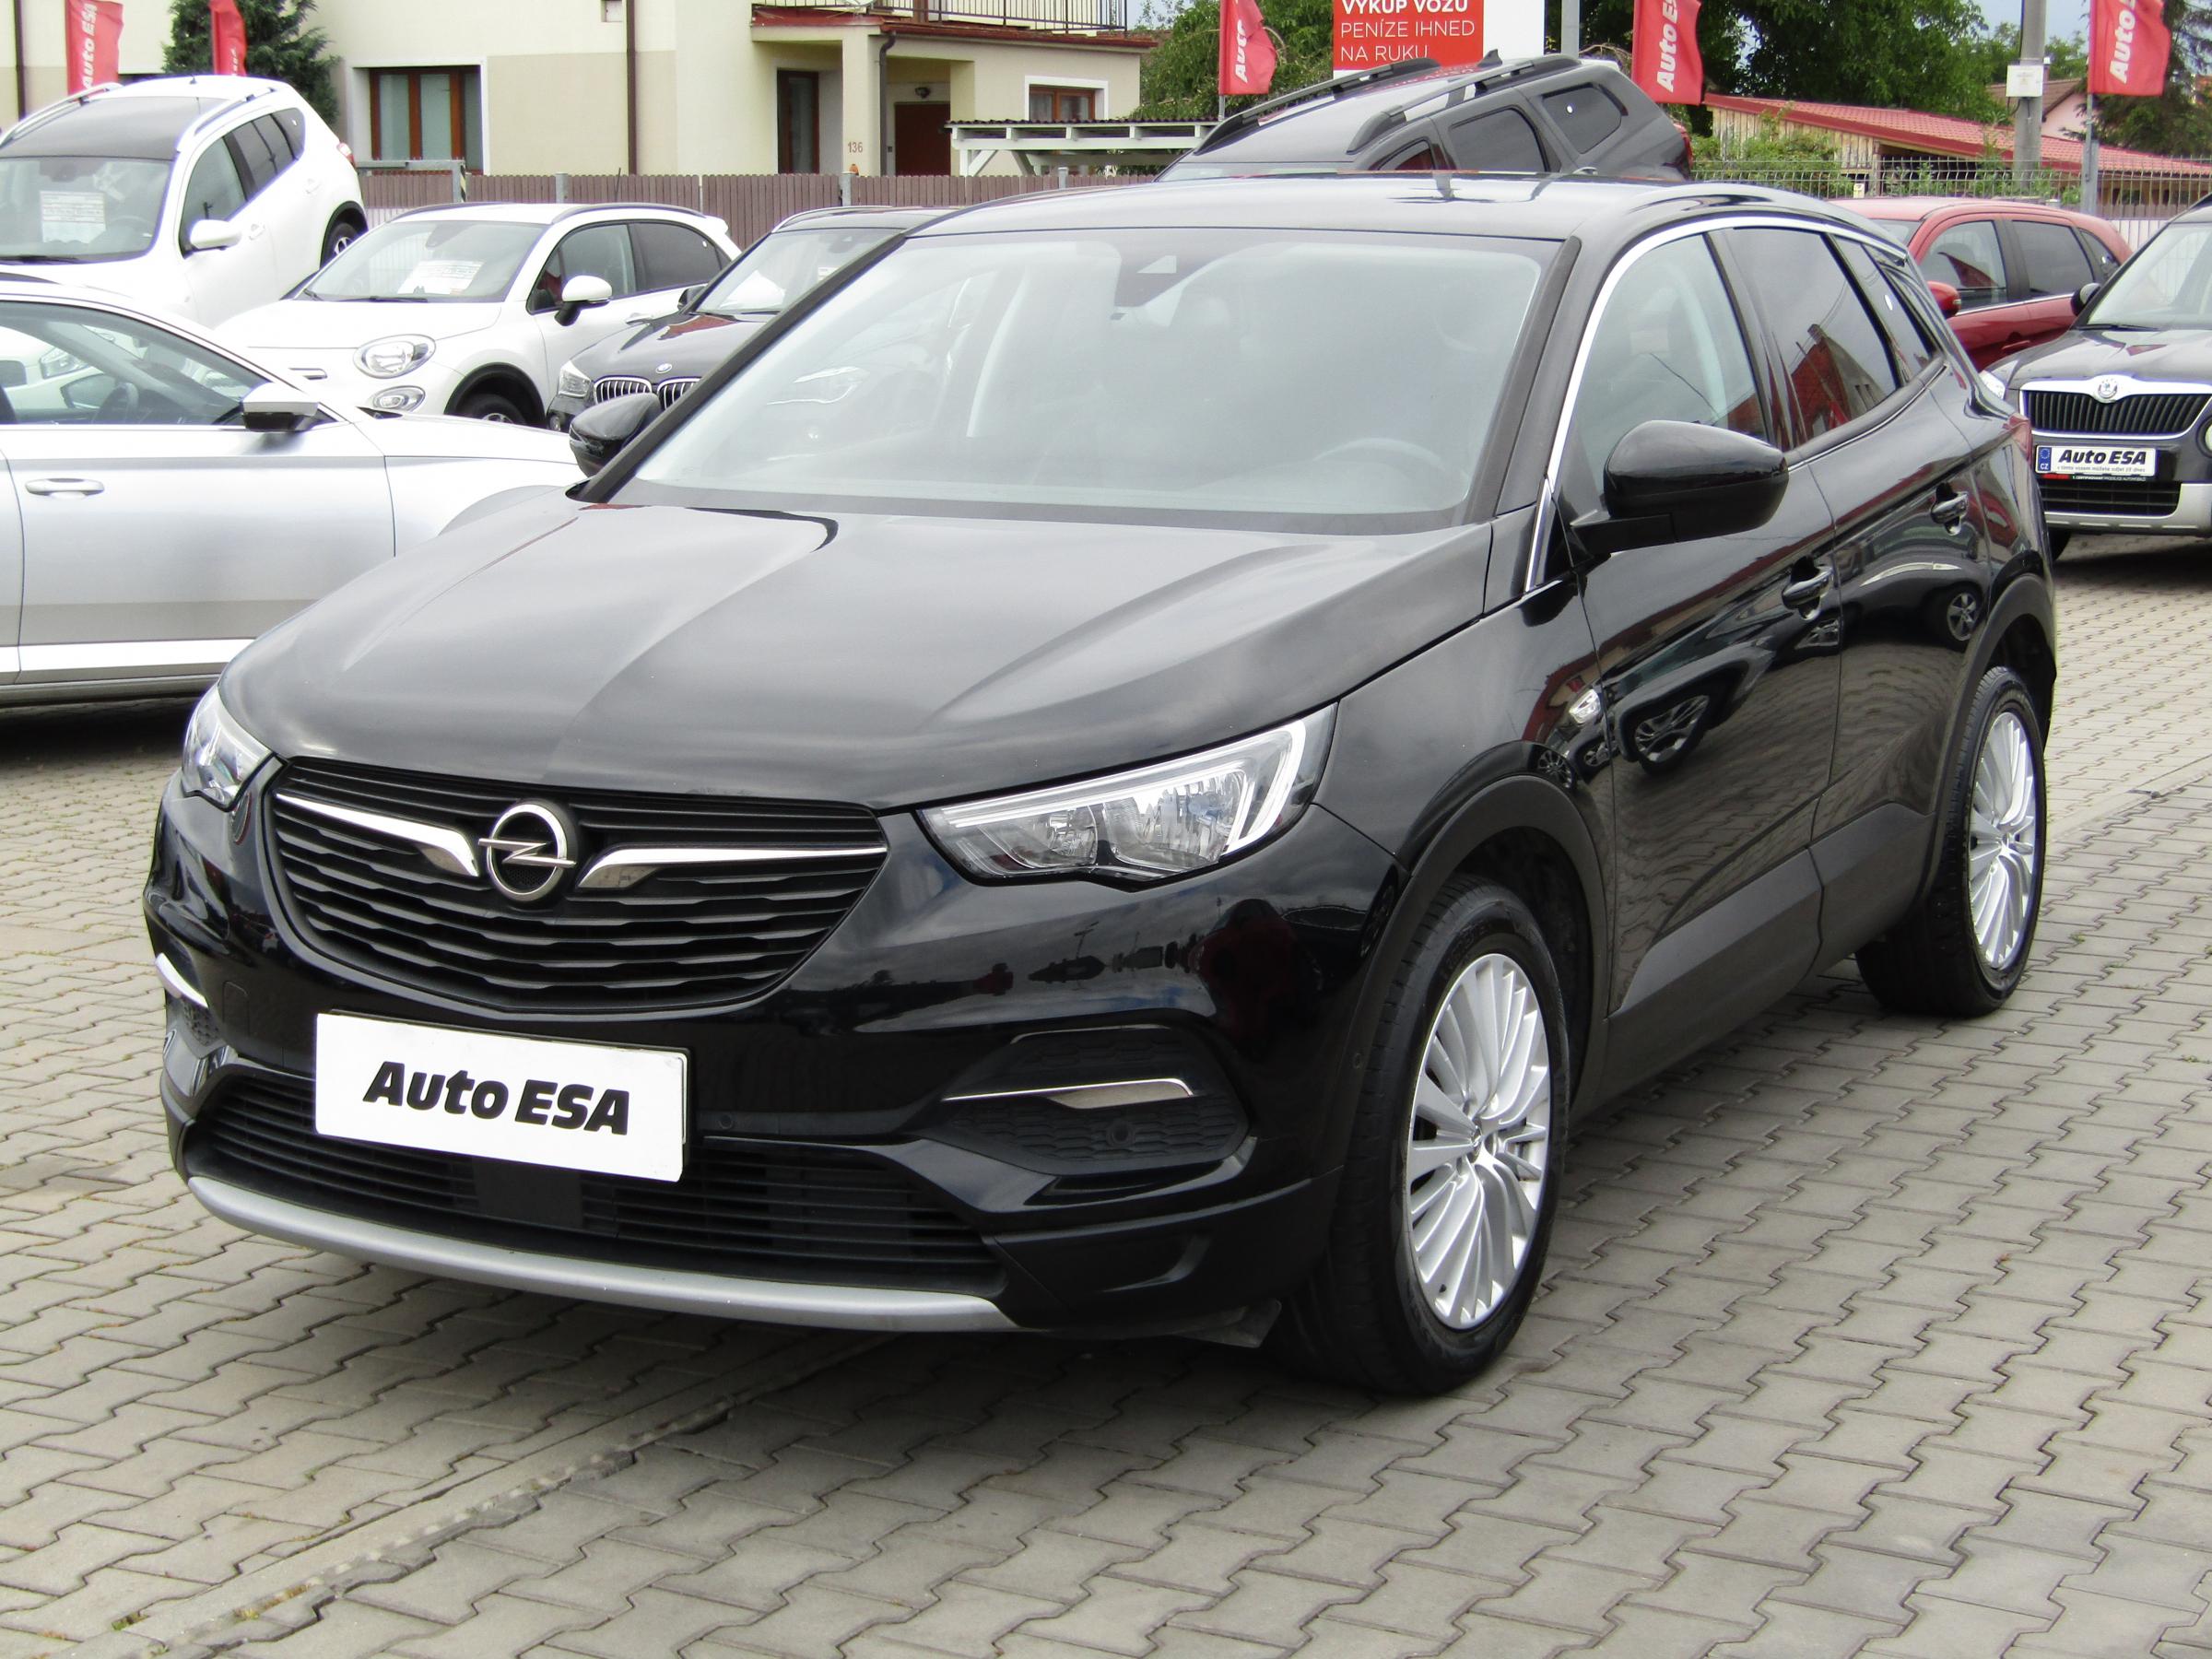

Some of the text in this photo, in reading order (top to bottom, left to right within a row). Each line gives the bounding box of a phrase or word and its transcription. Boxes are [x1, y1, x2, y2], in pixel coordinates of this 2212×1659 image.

[1341, 18, 1475, 38] PENÍZE IHNED
[1340, 44, 1428, 62] NA RUKU
[2109, 9, 2136, 84] Auto
[1657, 23, 1677, 93] Auto
[848, 141, 864, 153] 136
[2058, 449, 2147, 465] Auto ESA
[362, 1061, 629, 1136] Auto ESA
